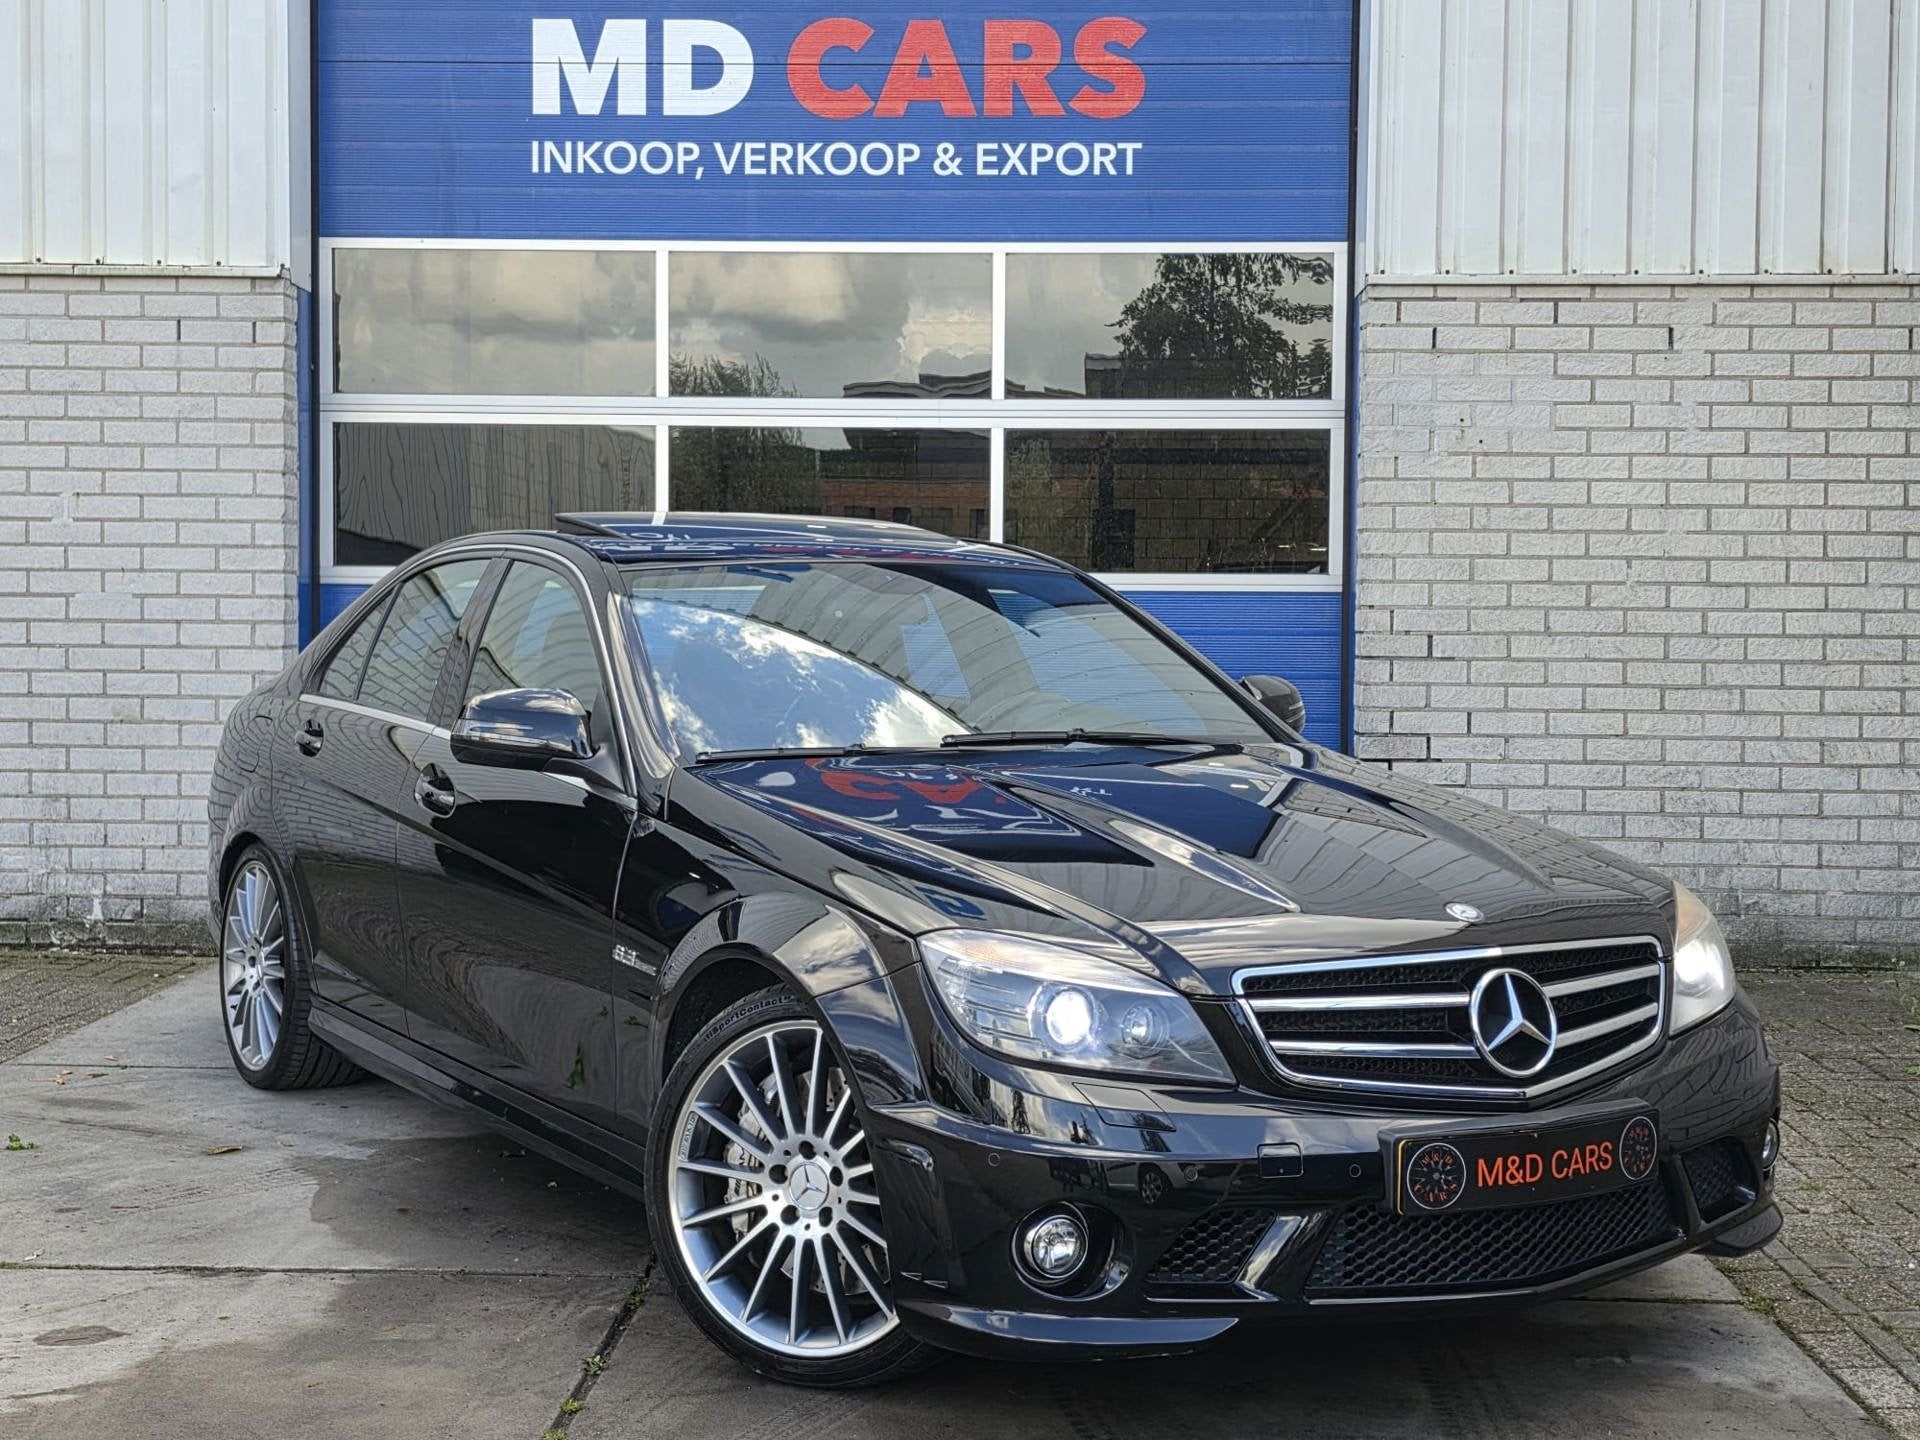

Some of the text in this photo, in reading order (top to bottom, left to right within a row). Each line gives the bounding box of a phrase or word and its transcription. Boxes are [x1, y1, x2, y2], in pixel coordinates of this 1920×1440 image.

[532, 17, 1147, 119] MD CARS
[531, 140, 1143, 180] INKOOP, VERKOOP & EXPORT
[1477, 1153, 1543, 1188] M&D
[1551, 1141, 1613, 1179] CARS
